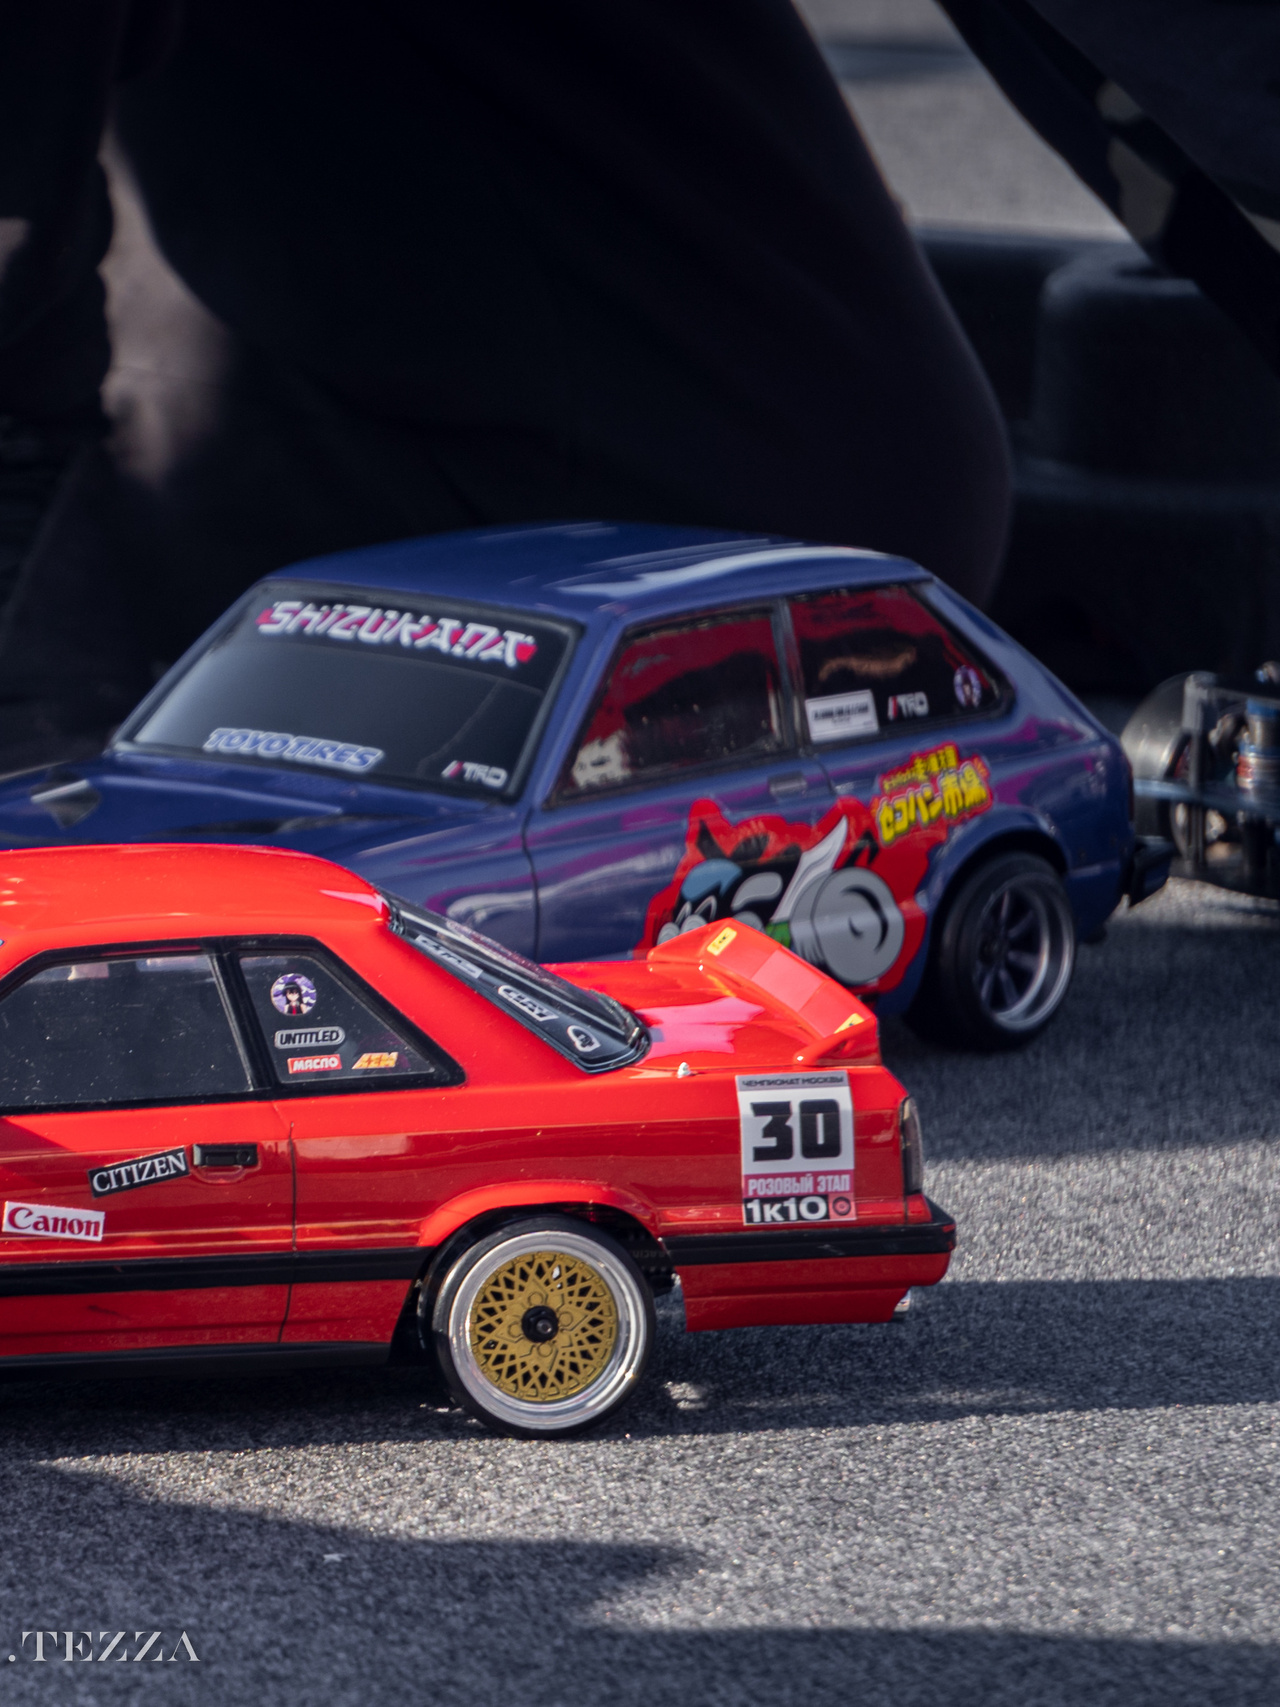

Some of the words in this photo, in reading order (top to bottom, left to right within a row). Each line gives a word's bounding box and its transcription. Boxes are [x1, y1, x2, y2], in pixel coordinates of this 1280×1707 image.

[279, 1029, 340, 1046] UNTITLED
[750, 1099, 842, 1162] 30
[93, 1152, 187, 1192] CITIZEN
[748, 1173, 814, 1196] РОЗОВЫЙ
[817, 1174, 851, 1193] ЭТАП
[8, 1206, 101, 1237] Canon
